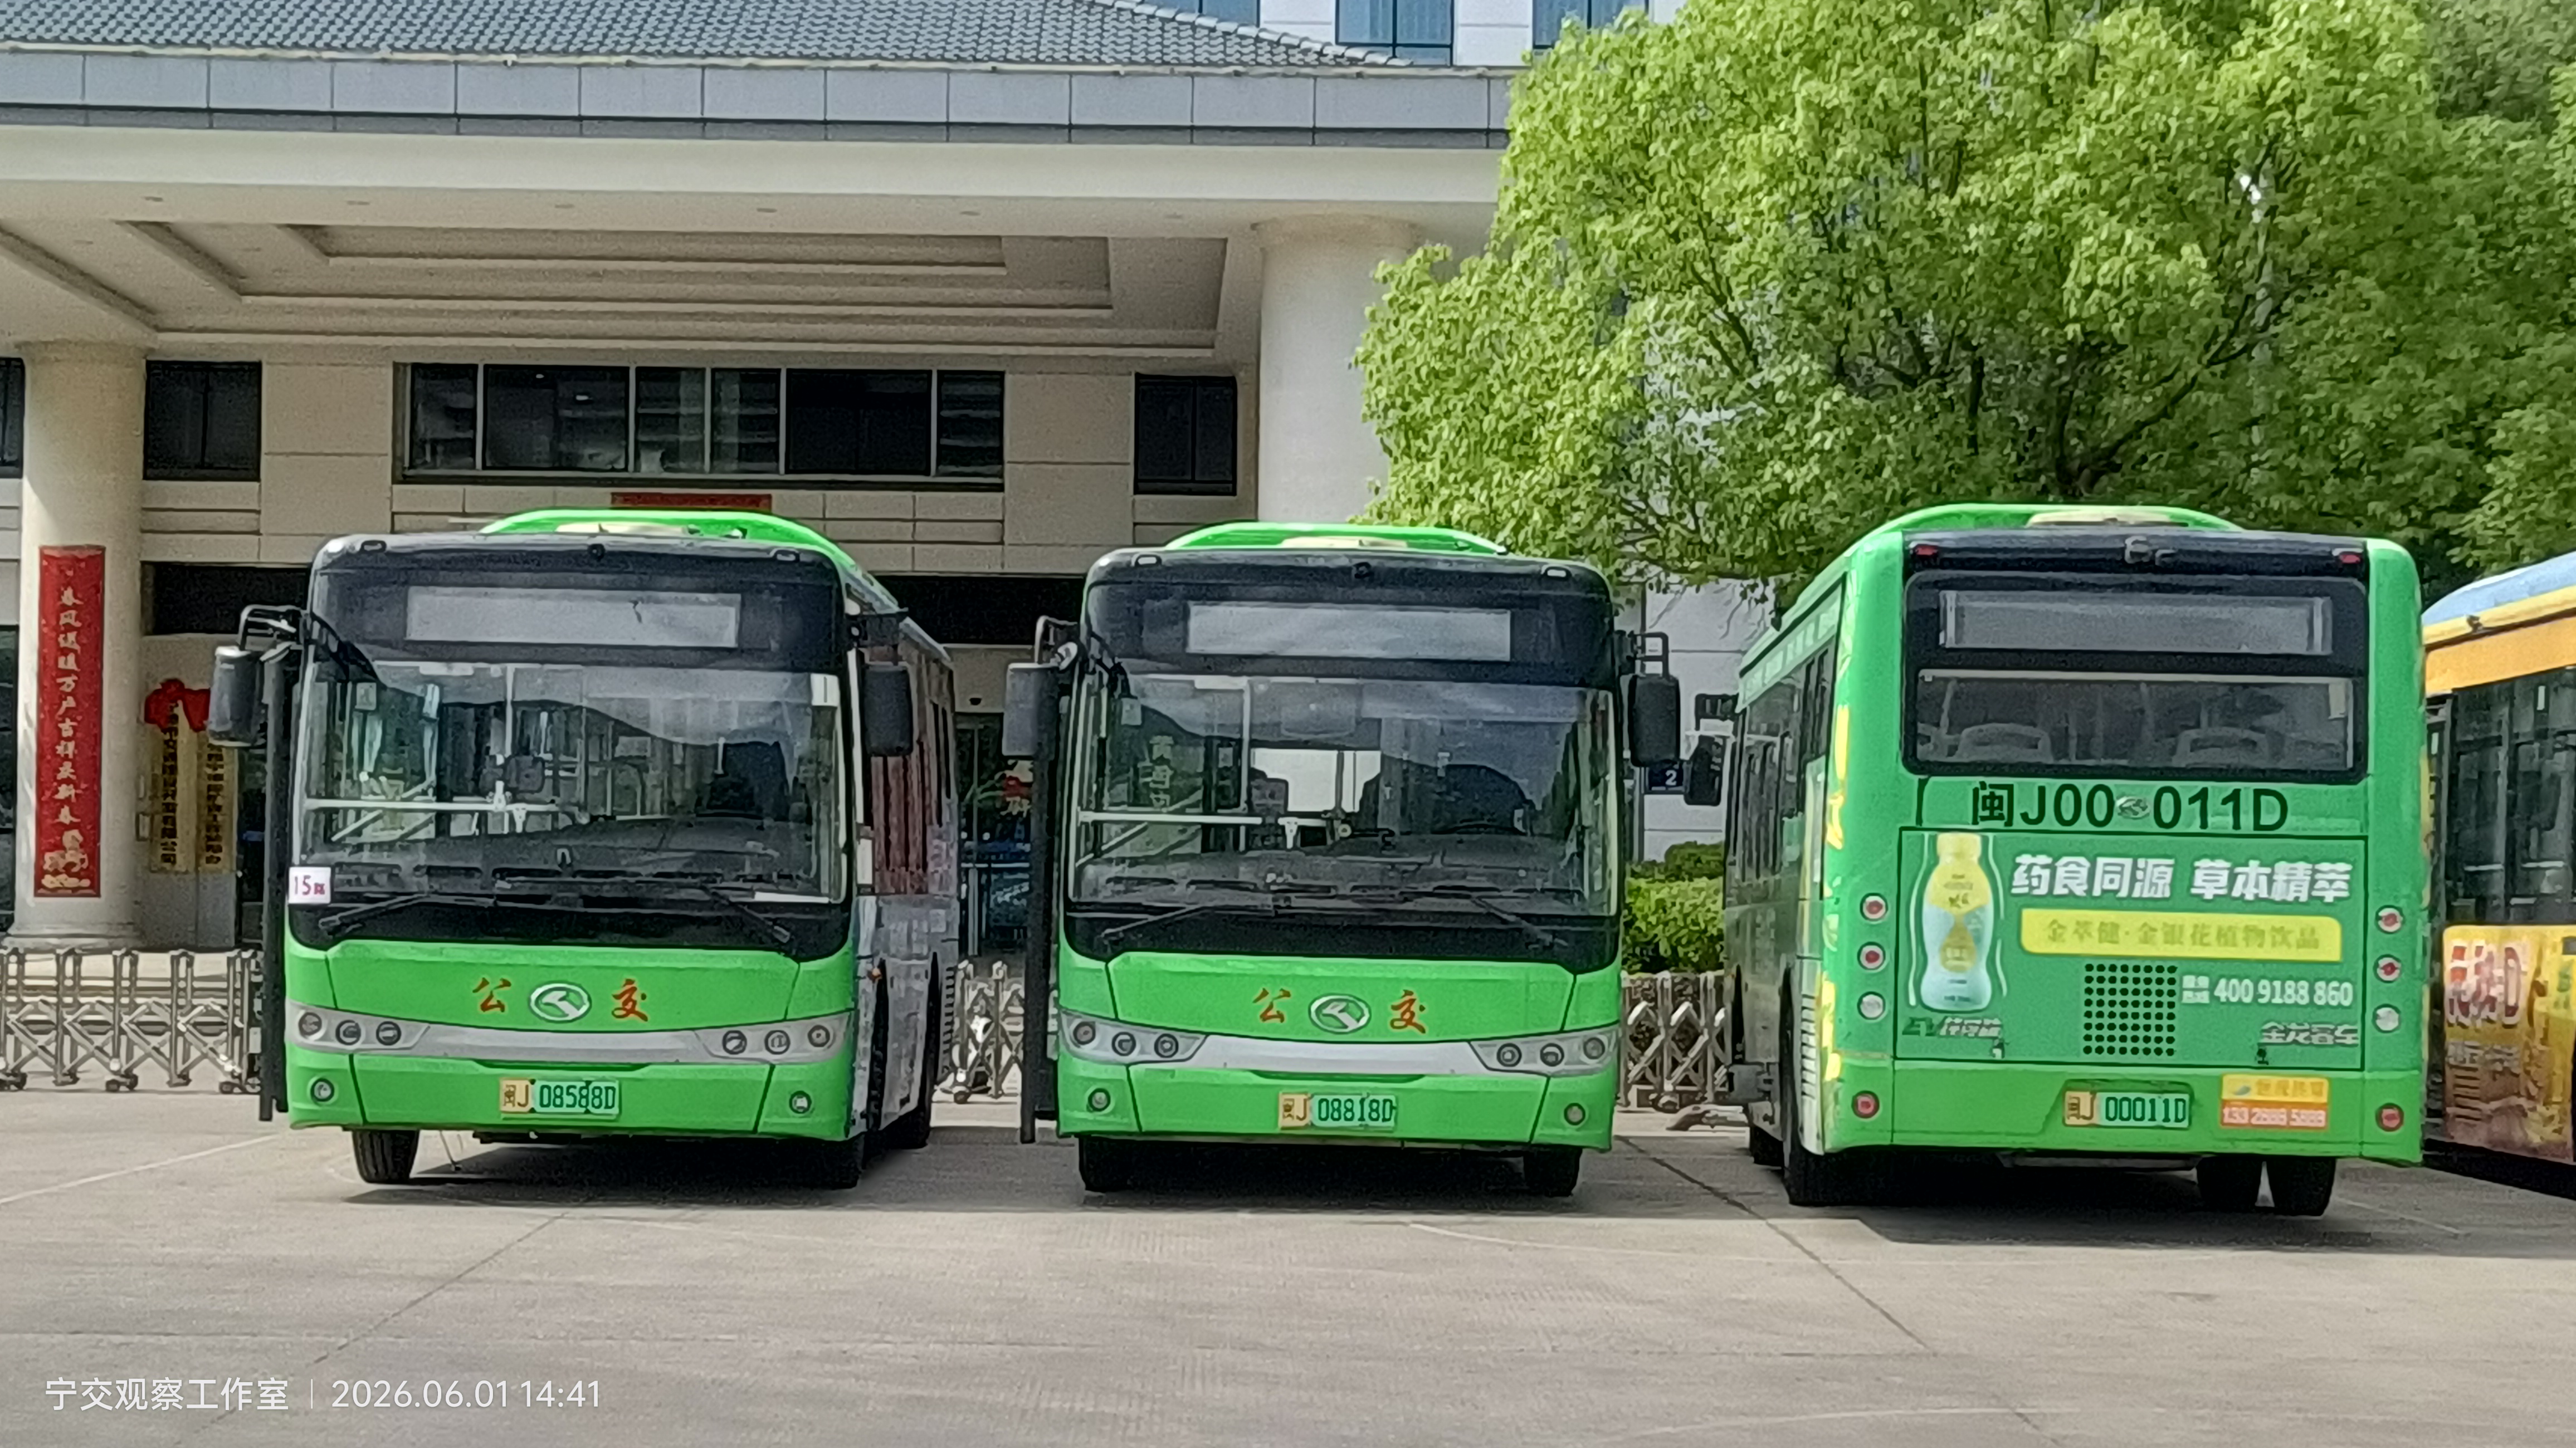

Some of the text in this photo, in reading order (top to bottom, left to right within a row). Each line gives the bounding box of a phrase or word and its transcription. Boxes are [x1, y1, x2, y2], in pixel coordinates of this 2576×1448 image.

[1972, 781, 2288, 831] 闽J00 011D
[2011, 855, 2352, 902] 药食同源 草本精萃
[472, 977, 648, 1021] 公 交
[2214, 978, 2253, 1003] 400
[2258, 979, 2309, 1005] 9188
[2314, 981, 2353, 1006] 860
[1253, 988, 1427, 1034] 公 交
[539, 1084, 617, 1109] 08588D
[1318, 1098, 1394, 1122] 08818D
[2105, 1096, 2187, 1123] 00011D
